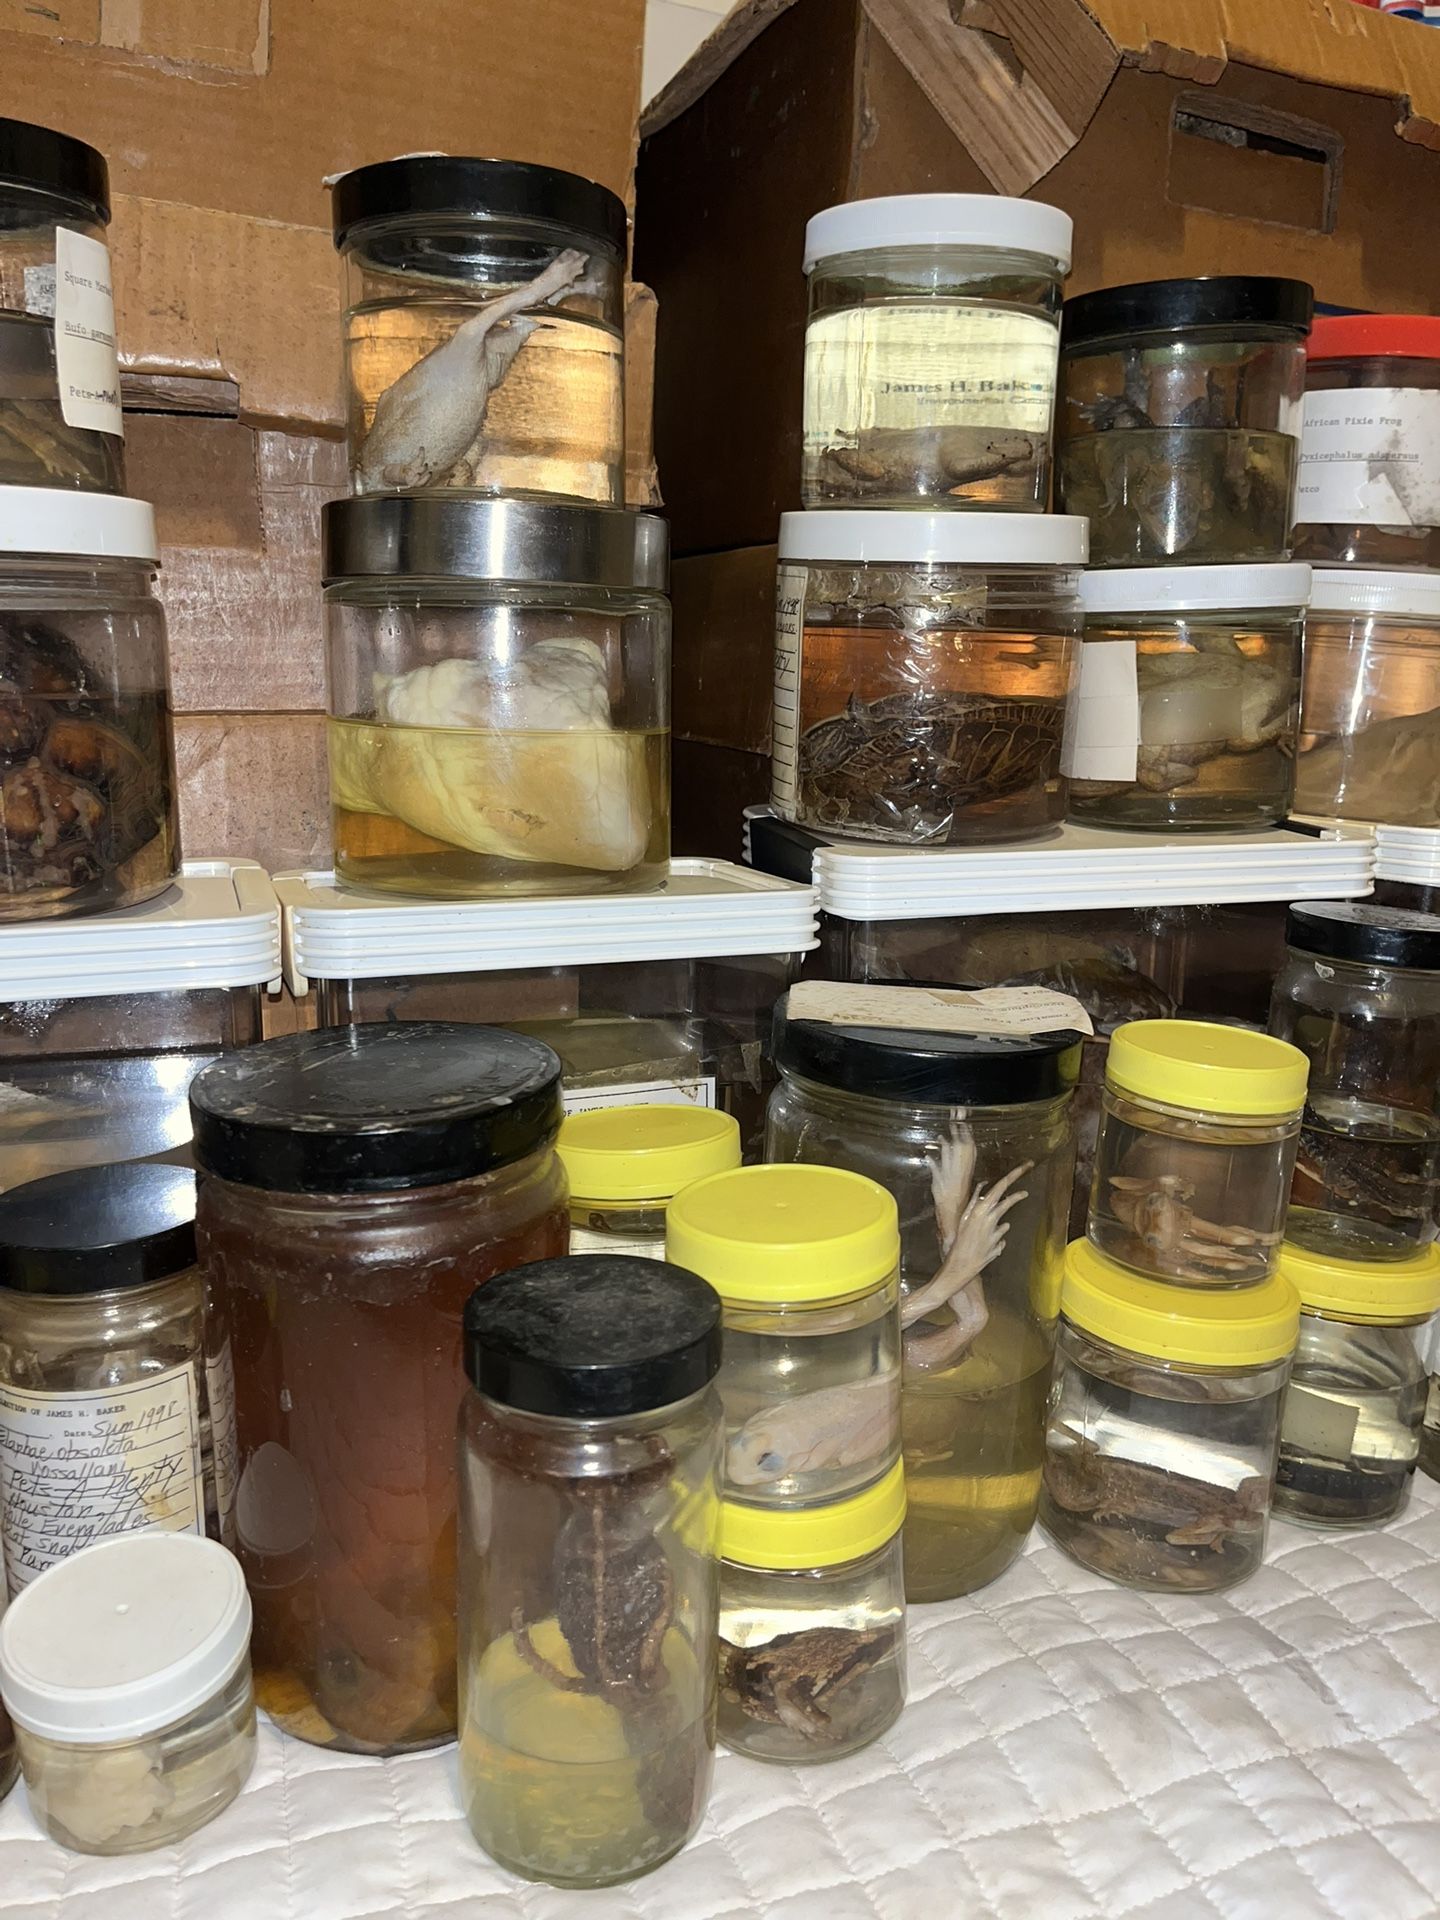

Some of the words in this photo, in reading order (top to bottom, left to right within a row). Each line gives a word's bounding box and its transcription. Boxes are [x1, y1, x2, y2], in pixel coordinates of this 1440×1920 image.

[880, 381, 942, 394] James
[1304, 418, 1340, 428] African
[1345, 417, 1374, 425] Pixie
[1379, 417, 1403, 427] Frog
[31, 1408, 41, 1417] OF
[46, 1410, 73, 1418] JAMES
[97, 1404, 126, 1416] BAKER
